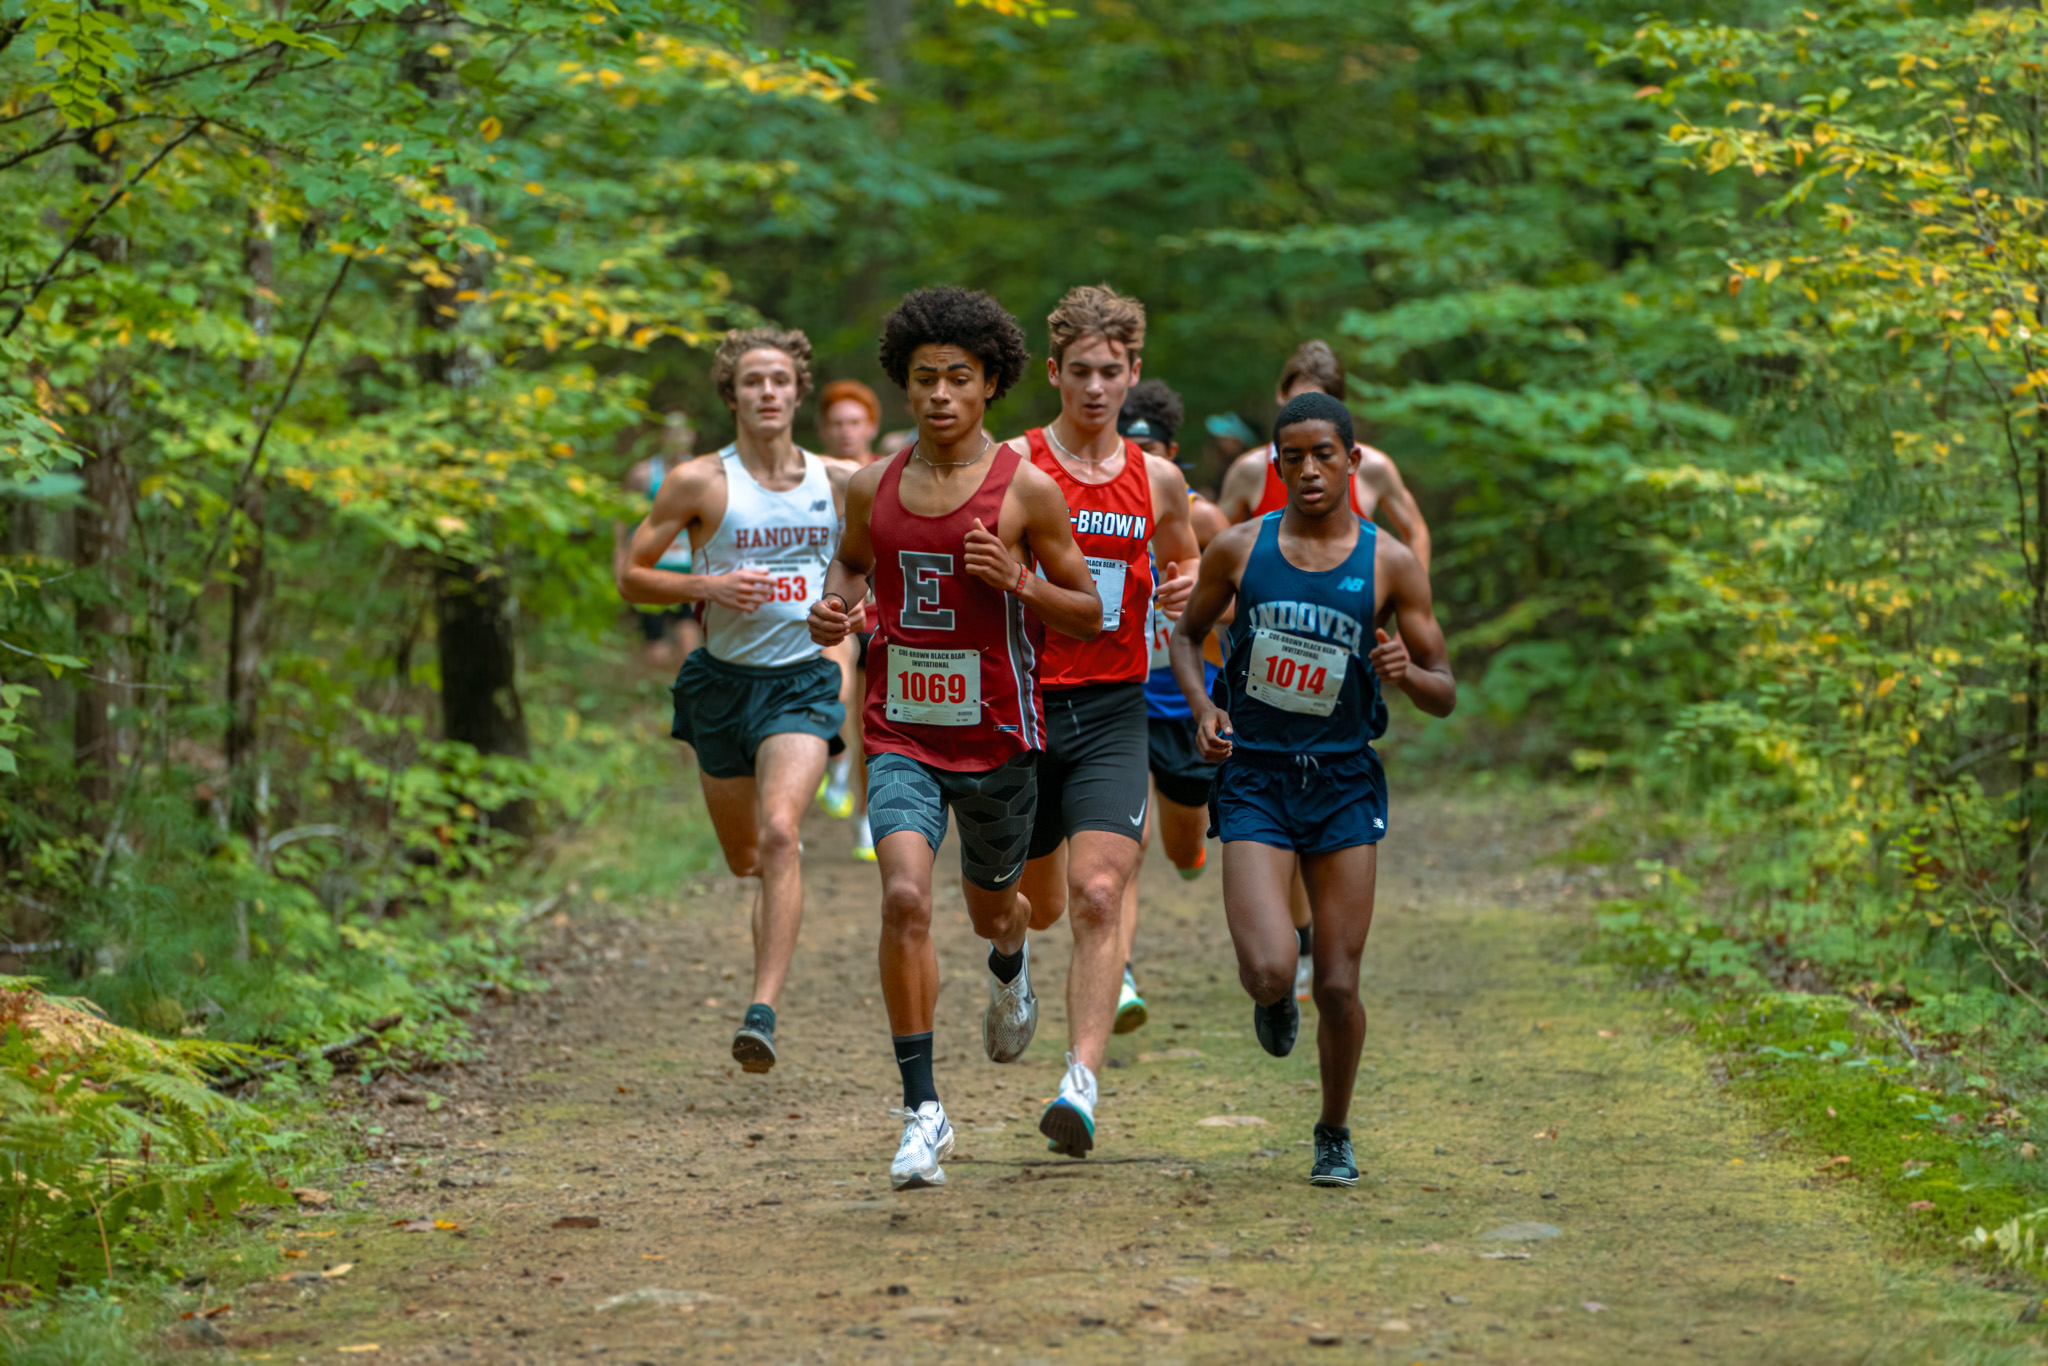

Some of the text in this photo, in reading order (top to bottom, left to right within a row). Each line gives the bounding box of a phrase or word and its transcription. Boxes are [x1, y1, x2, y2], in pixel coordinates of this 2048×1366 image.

[1068, 508, 1147, 540] -BROWN
[736, 527, 828, 549] HANOVER
[899, 550, 955, 631] E
[1337, 576, 1365, 592] NB
[930, 652, 950, 660] BLACK
[950, 652, 966, 660] BEAR
[1281, 645, 1319, 660] INVITATIONAL
[1303, 641, 1321, 652] BLACK
[1322, 646, 1336, 655] BEAR
[911, 660, 949, 668] INVITATIONAL
[1265, 654, 1327, 695] 1014
[898, 670, 966, 704] 1069
